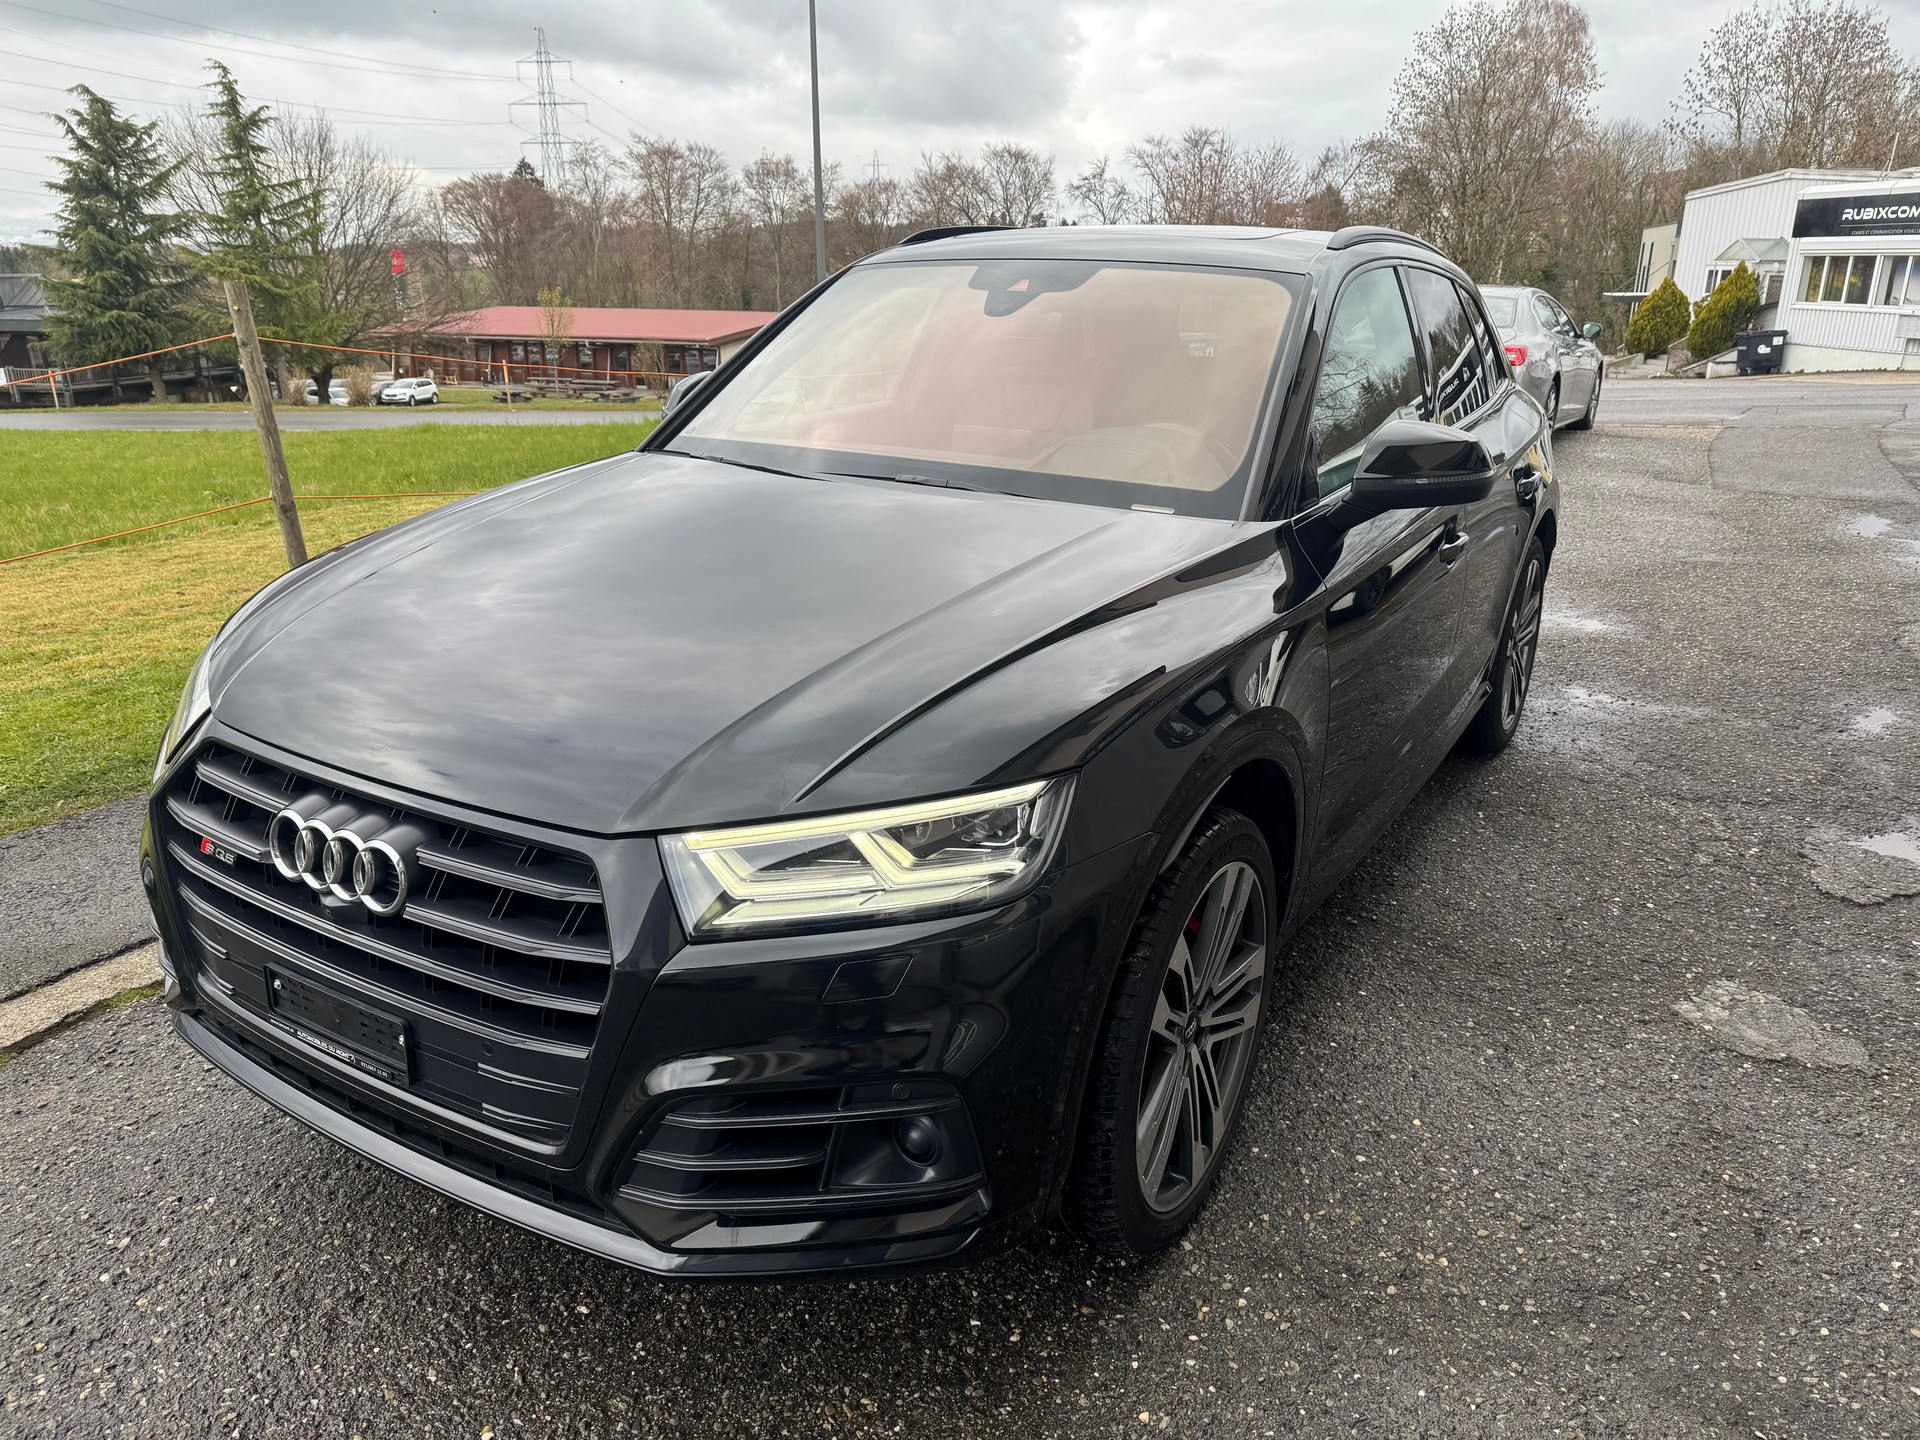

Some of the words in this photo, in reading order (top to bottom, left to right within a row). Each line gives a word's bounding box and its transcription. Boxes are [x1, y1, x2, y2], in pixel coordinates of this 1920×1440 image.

[1842, 204, 1920, 221] RUBIXCOM
[203, 841, 234, 865] SQ5
[296, 1030, 328, 1049] AUTOMOBILES
[328, 1044, 336, 1053] DU
[335, 1047, 350, 1060] MONT
